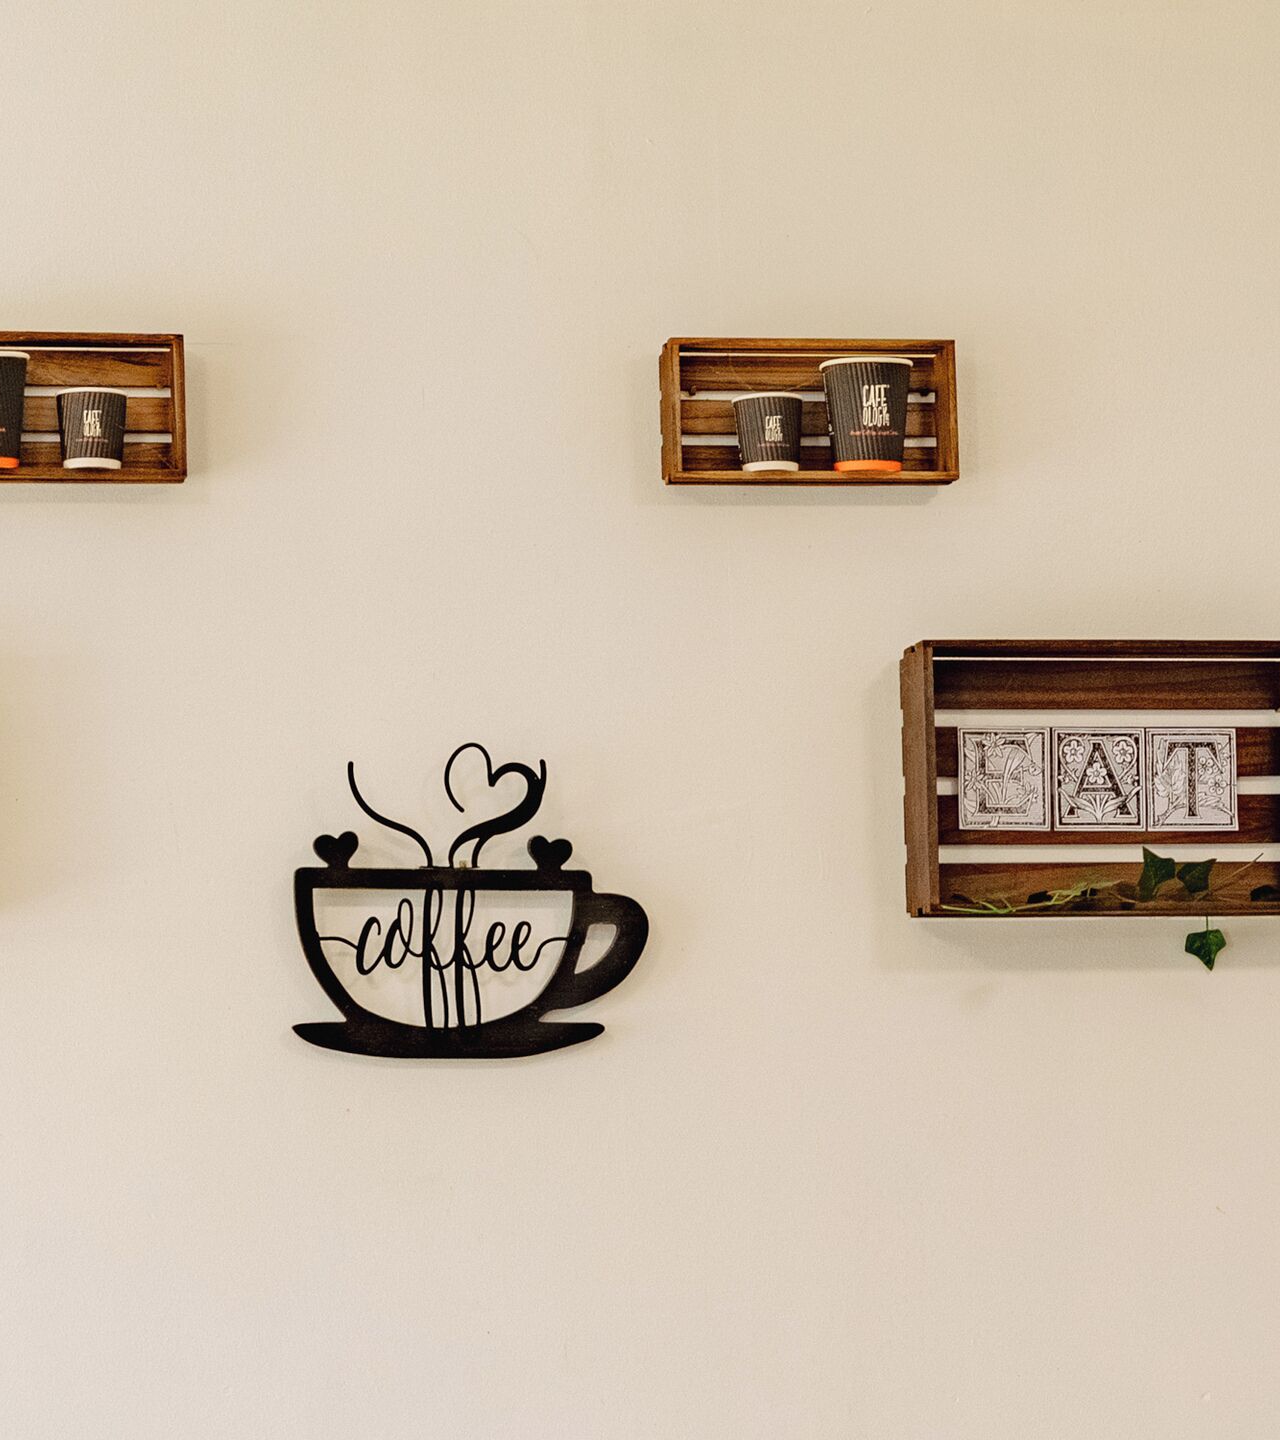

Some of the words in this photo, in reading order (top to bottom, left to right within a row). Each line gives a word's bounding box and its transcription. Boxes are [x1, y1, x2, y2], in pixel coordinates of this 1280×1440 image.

[863, 384, 888, 407] CAFE
[975, 736, 1229, 820] EAT
[342, 886, 550, 1028] coffee
